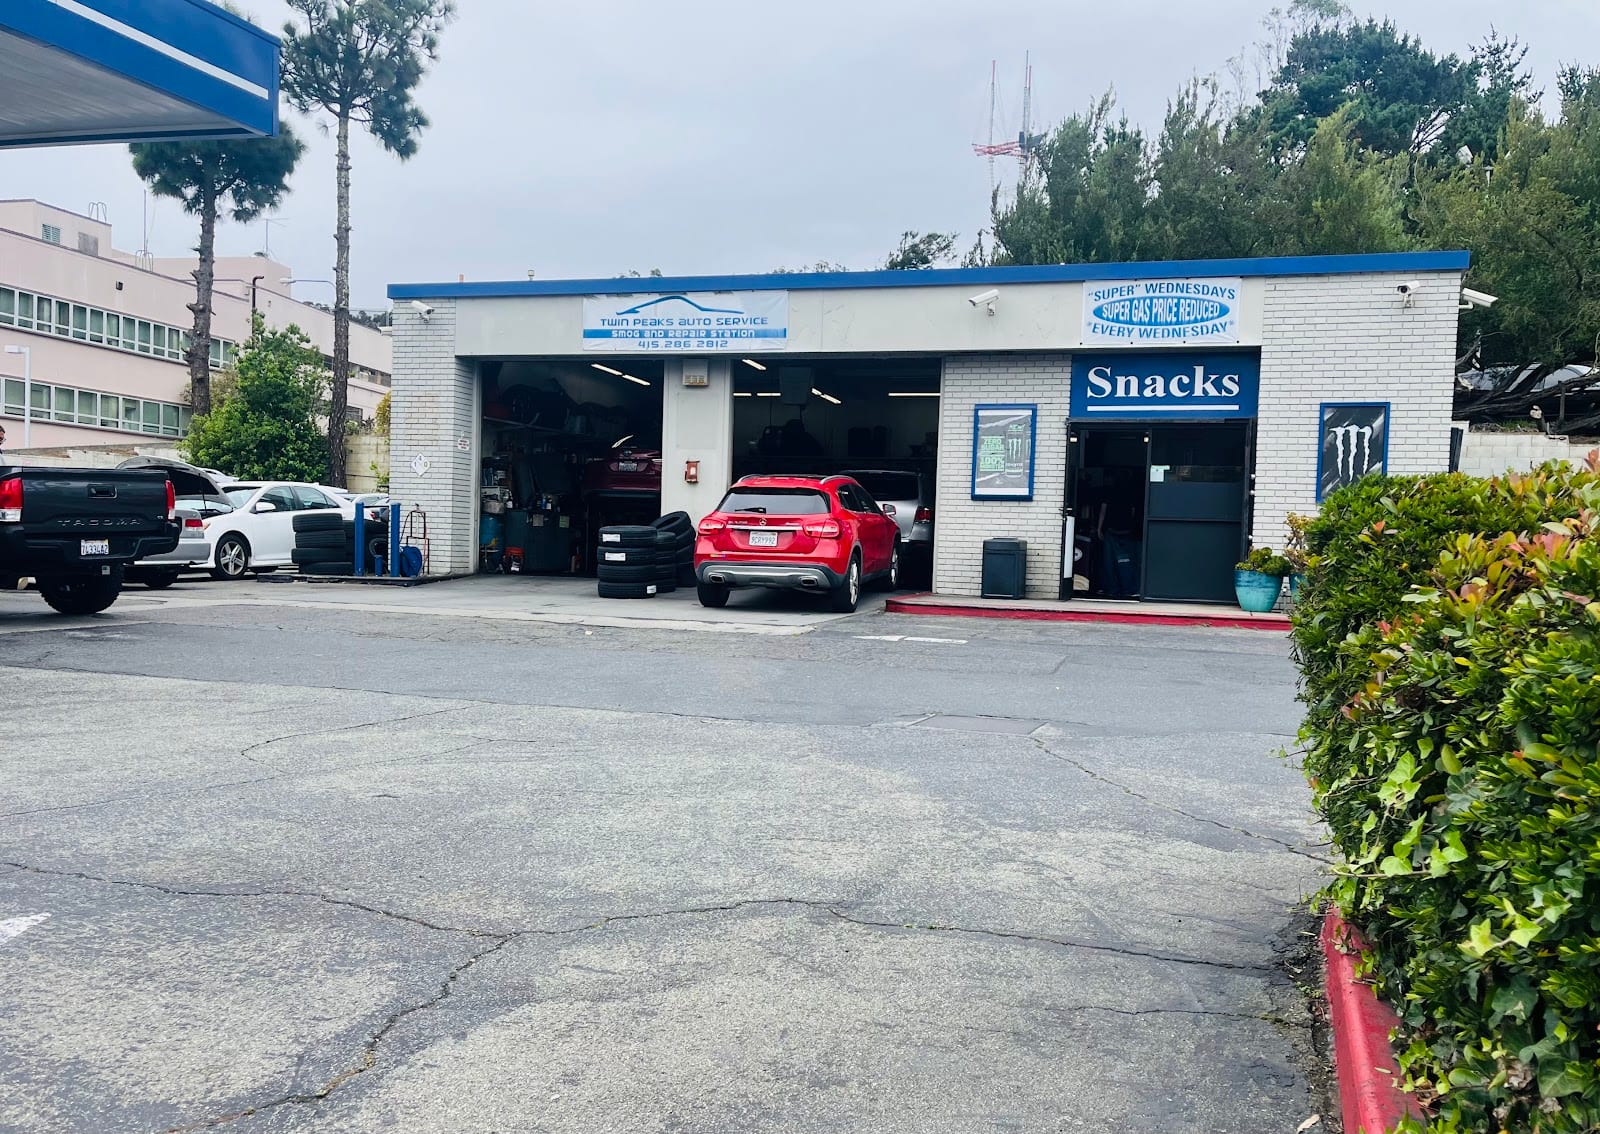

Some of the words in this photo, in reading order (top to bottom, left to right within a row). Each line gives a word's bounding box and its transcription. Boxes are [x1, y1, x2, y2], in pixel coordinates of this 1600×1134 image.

[1145, 282, 1236, 300] WEDNESDAYS
[1102, 300, 1131, 320] SUPER
[1131, 299, 1151, 322] GAS
[1152, 298, 1178, 323] PRICE
[1179, 300, 1221, 322] REDUCED
[600, 318, 629, 327] TWIN
[633, 318, 674, 327] PEAKS
[678, 317, 712, 326] AUTO
[716, 316, 768, 326] SERVICE
[611, 329, 640, 338] SMOG
[643, 329, 664, 338] AND
[668, 329, 706, 338] REPAIR
[710, 328, 755, 338] STATION
[1087, 365, 1240, 399] Snacks
[57, 519, 141, 527] TACOMA
